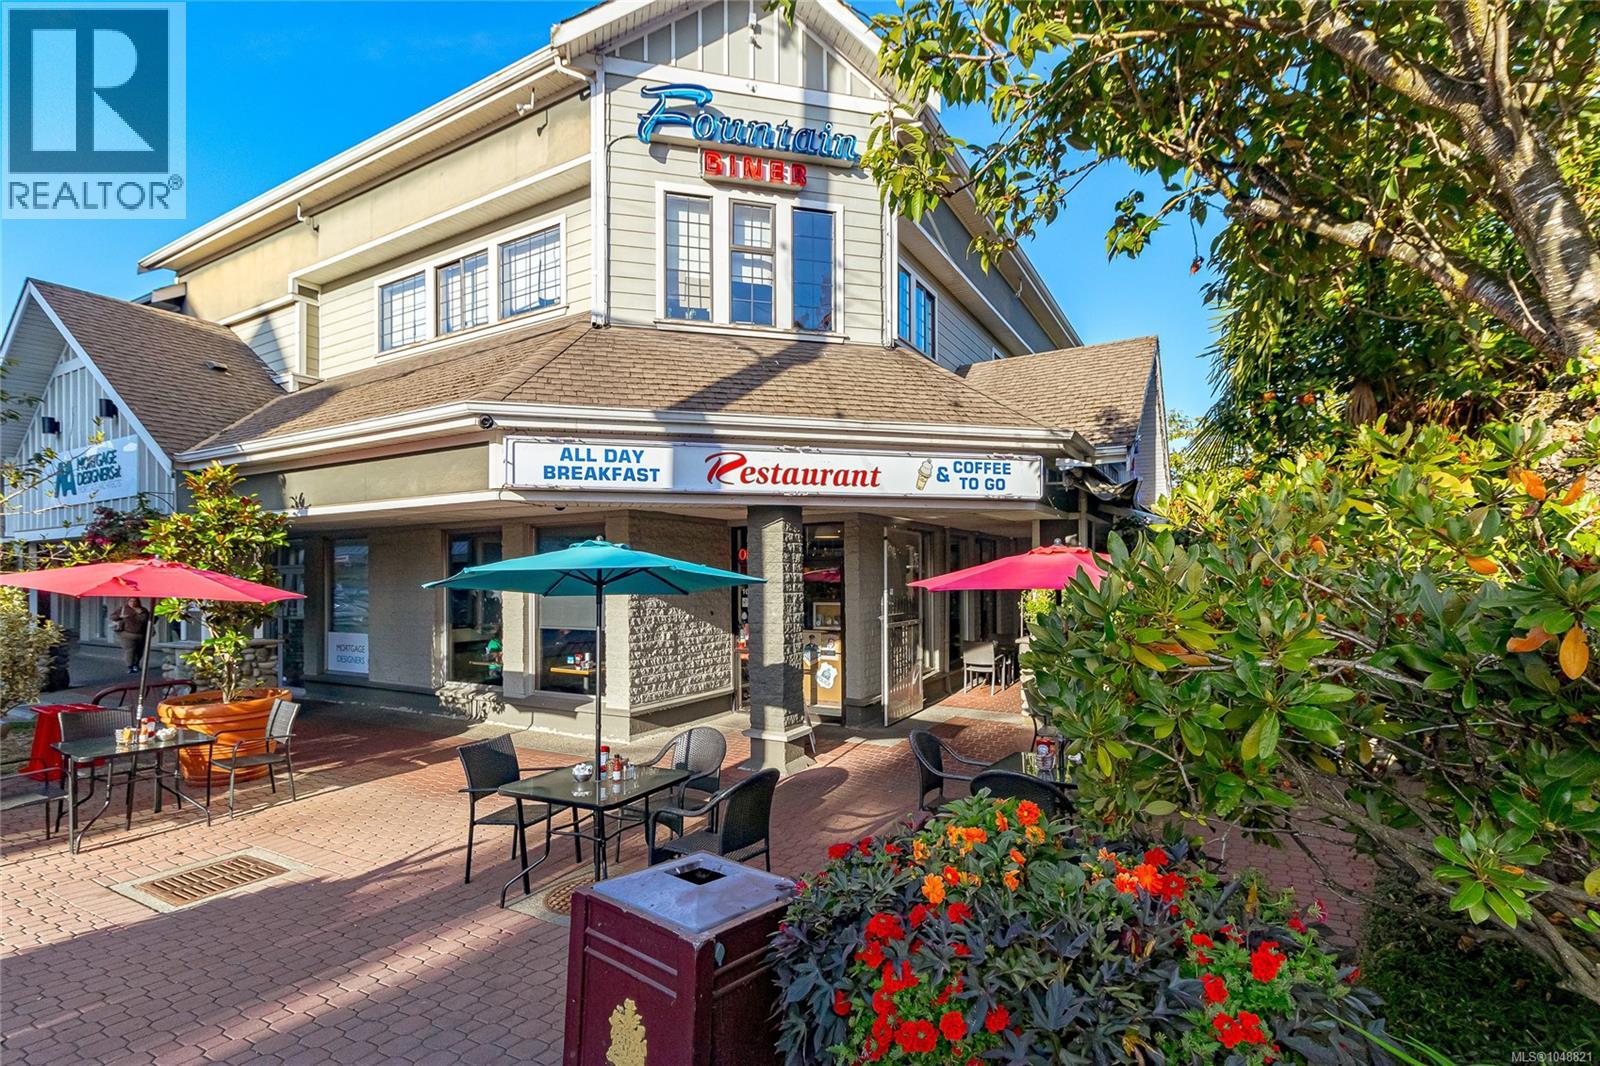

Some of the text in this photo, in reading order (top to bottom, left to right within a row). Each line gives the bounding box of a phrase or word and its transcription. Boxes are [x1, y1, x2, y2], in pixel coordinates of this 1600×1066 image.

[637, 83, 861, 161] Fountain
[703, 150, 808, 187] DINER
[560, 447, 644, 464] ALL DAY
[543, 465, 660, 482] BREAKFAST
[704, 451, 882, 488] Restaurant
[936, 460, 1011, 482] & COFFEE
[959, 477, 1006, 491] TO GO
[336, 644, 365, 653] MORTGAGE
[336, 655, 365, 664] DESIGNERS
